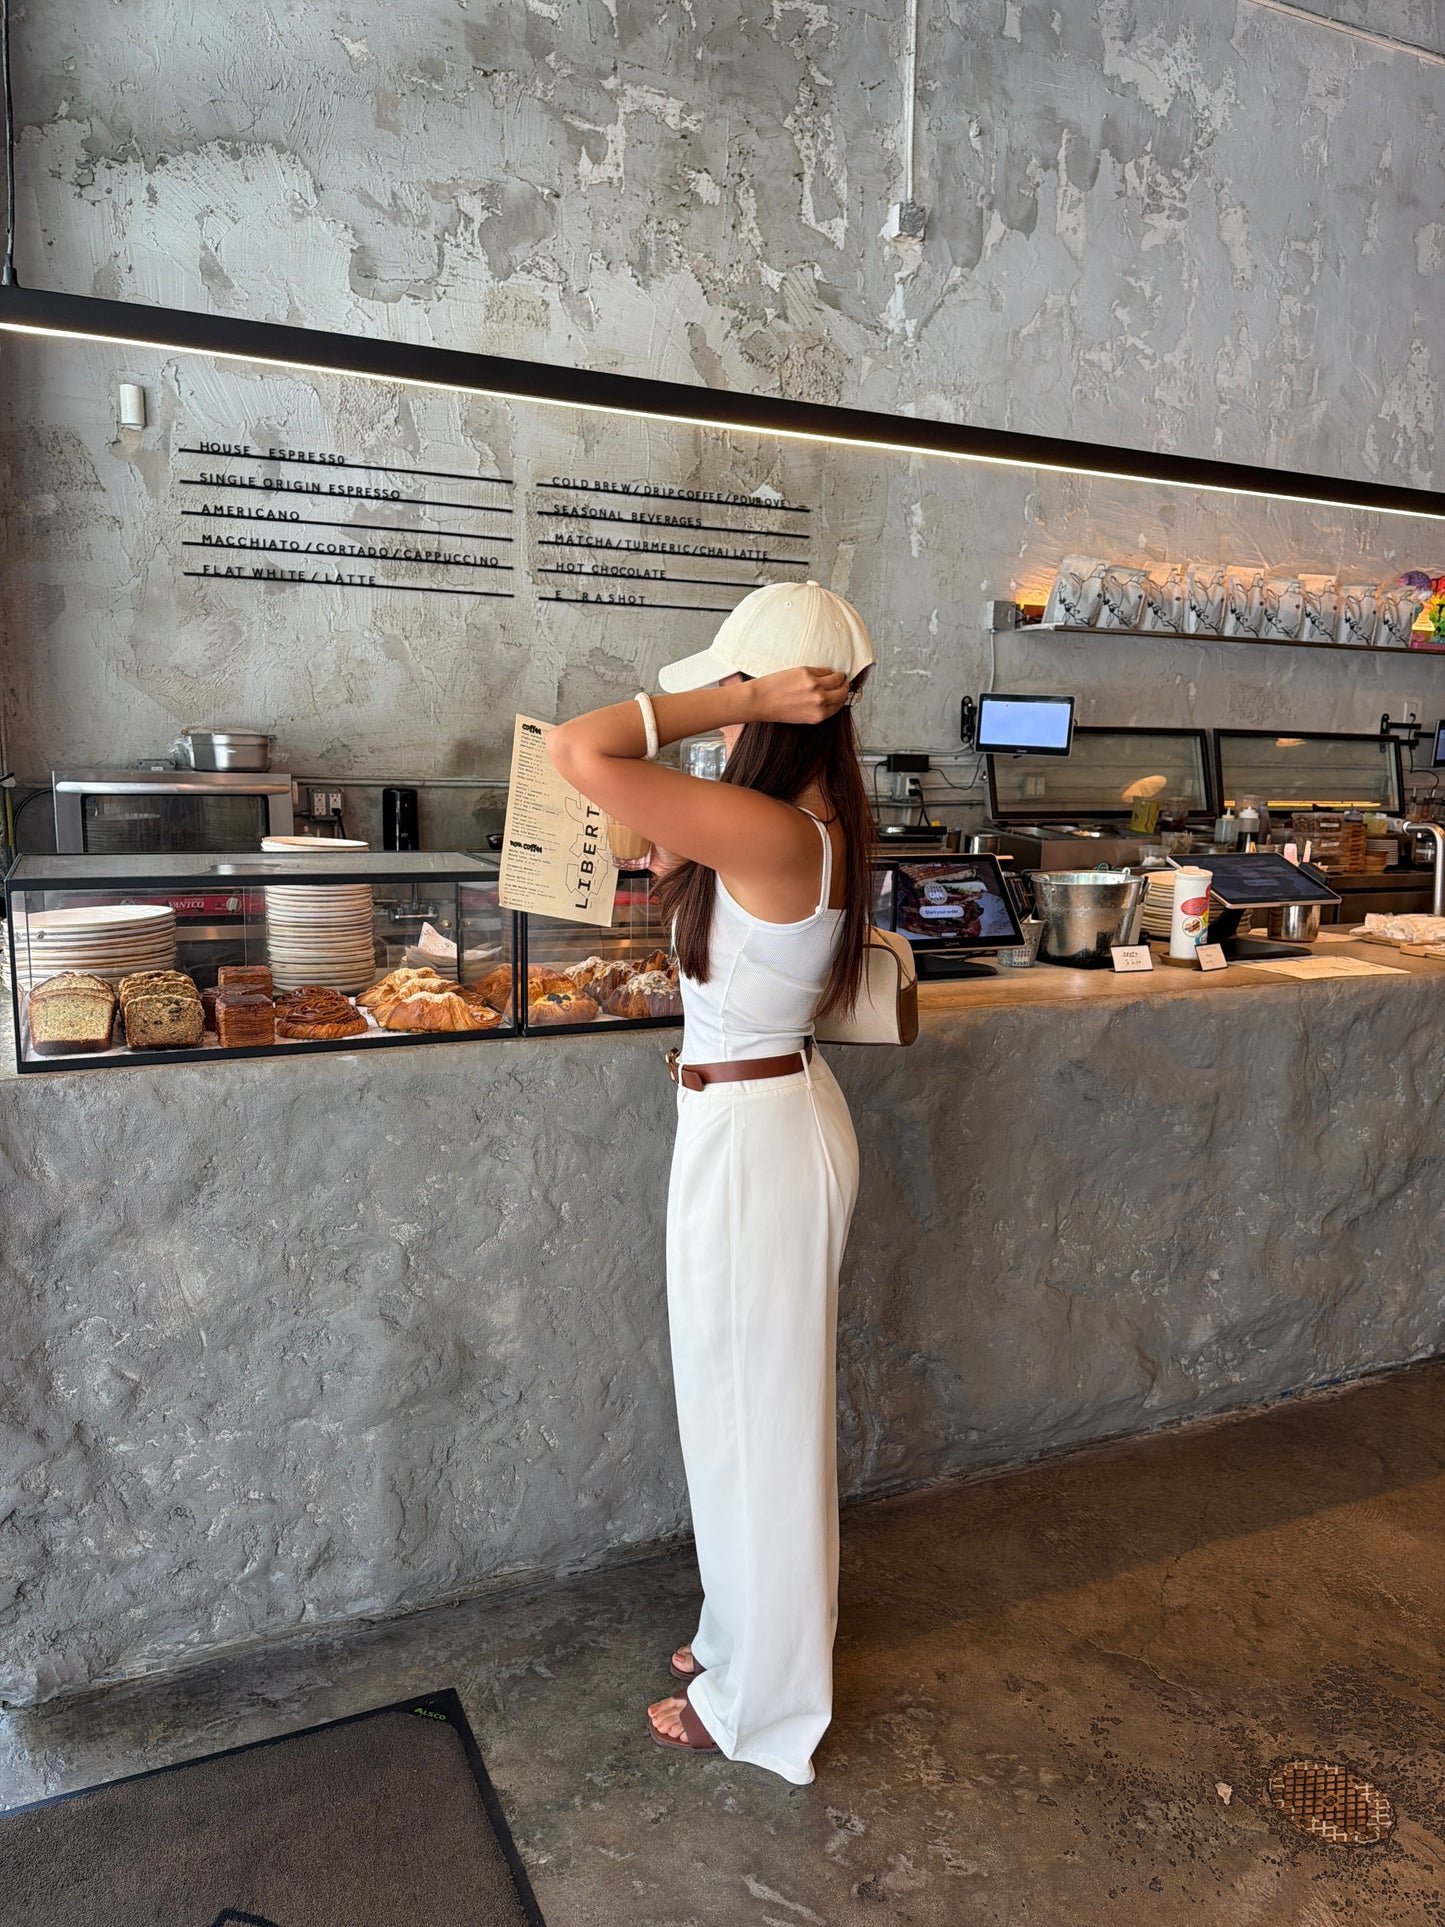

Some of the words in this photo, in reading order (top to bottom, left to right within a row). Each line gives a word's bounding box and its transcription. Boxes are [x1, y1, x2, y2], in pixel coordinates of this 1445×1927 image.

[200, 441, 251, 455] HOUSE
[268, 448, 345, 465] ESPRESSO
[200, 472, 256, 487] SINGLE
[262, 478, 320, 492] ORIGIN
[329, 484, 400, 500] ESPRESSO
[552, 476, 588, 489] COLD
[201, 503, 300, 521] AMERICANO
[553, 504, 623, 520] SEASONAL
[631, 512, 702, 527] BEVERAGES
[733, 548, 769, 561] LATTE
[203, 564, 244, 577] FLAT
[556, 562, 584, 573] HOT
[591, 564, 667, 579] CHOCOLATE
[608, 594, 646, 607] SHOT
[414, 1707, 446, 1721] ALSCO
